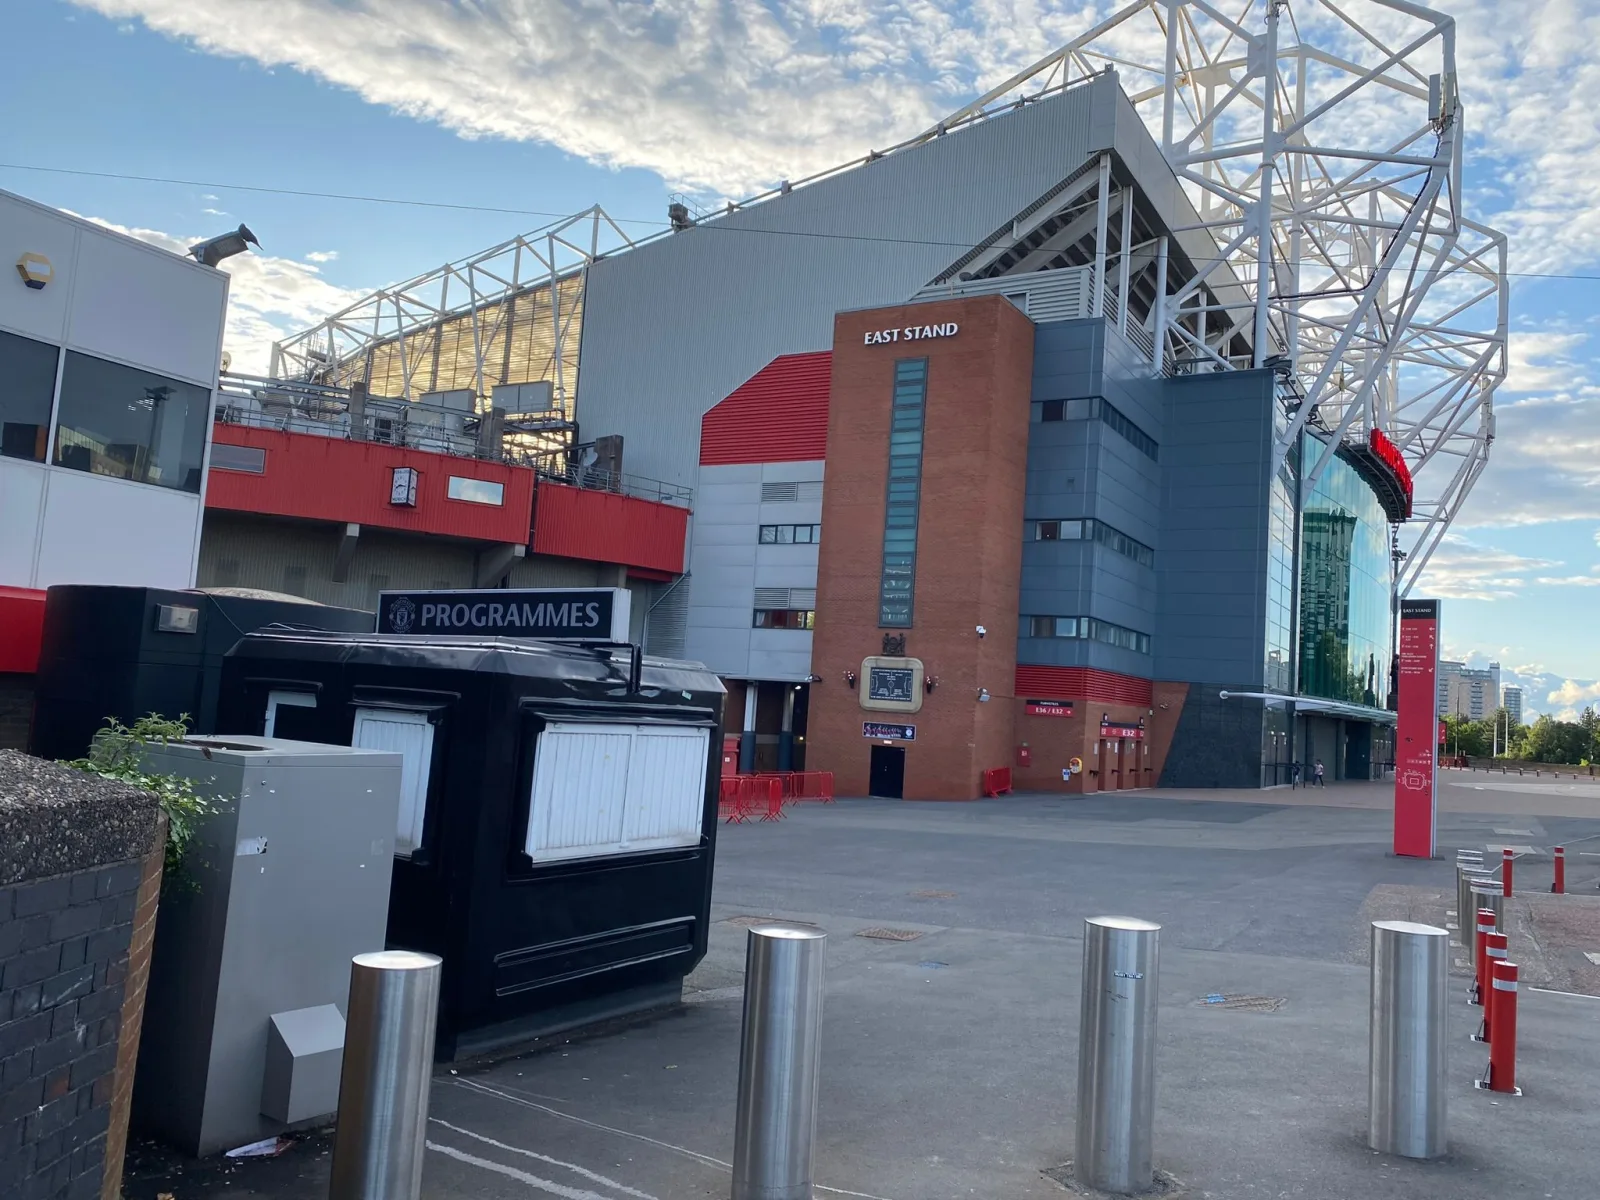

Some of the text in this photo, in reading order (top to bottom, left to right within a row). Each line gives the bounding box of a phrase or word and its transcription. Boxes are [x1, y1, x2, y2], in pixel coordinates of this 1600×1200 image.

[864, 322, 959, 345] EAST STAND
[421, 602, 600, 627] PROGRAMMES
[1122, 729, 1135, 737] E32
